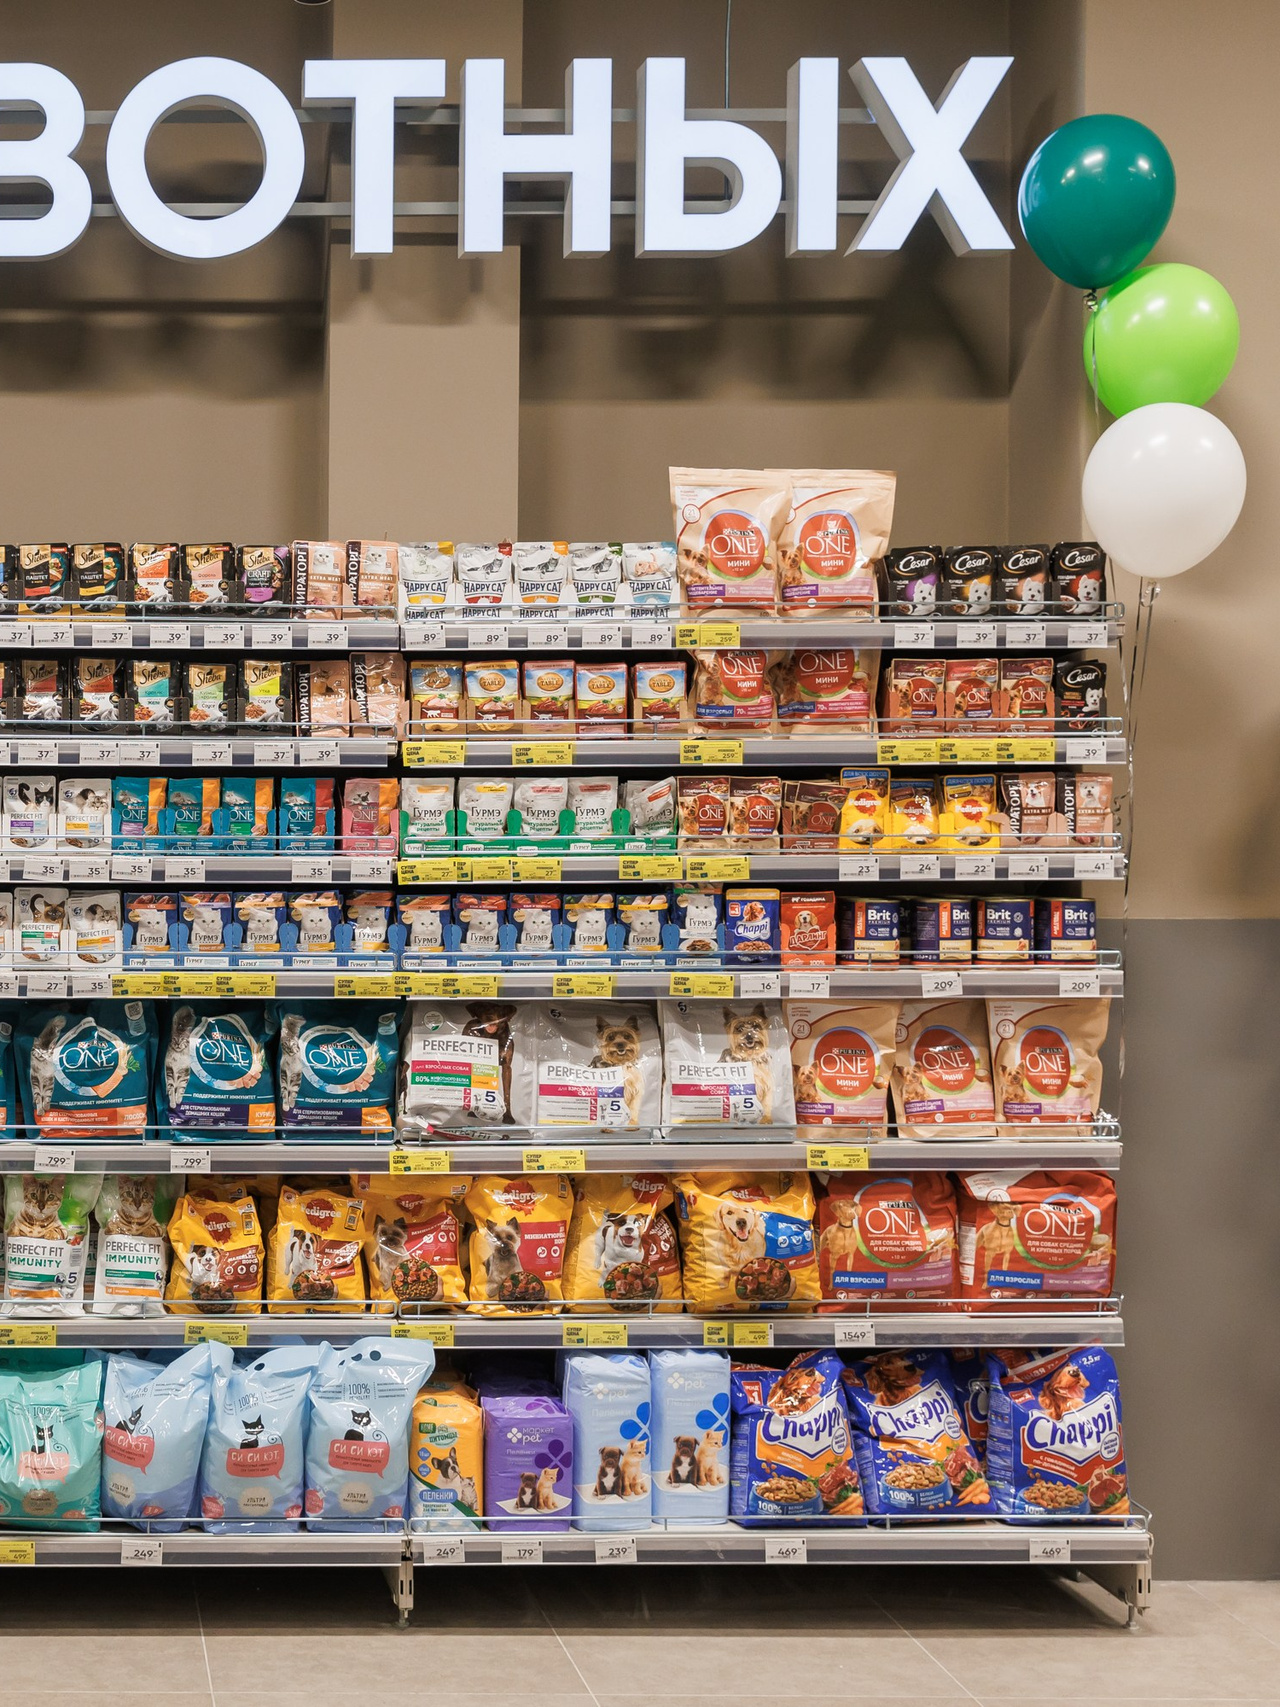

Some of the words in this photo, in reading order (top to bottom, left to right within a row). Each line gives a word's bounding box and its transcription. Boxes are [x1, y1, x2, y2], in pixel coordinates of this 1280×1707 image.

[712, 534, 758, 556] ONE
[806, 534, 852, 556] ONE
[728, 559, 750, 567] МИНИ
[822, 559, 844, 567] МИНИ
[900, 553, 933, 570] Cesar
[955, 555, 988, 572] Cesar
[1009, 553, 1044, 570] Cesar
[404, 582, 431, 592] HAPPY
[433, 582, 446, 592] CAT
[170, 633, 182, 641] 39
[424, 632, 436, 640] 89
[722, 655, 763, 676] ONE
[800, 652, 848, 672] ONE
[816, 676, 839, 684] МИНИ
[1067, 671, 1099, 686] Cesar
[318, 750, 331, 758] 39
[122, 810, 146, 820] ONE
[176, 810, 200, 820] ONE
[414, 807, 444, 818] ГУРМЭ
[472, 806, 502, 818] ГУРМЭ
[576, 806, 606, 818] ГУРМЭ
[868, 910, 891, 921] Brit
[987, 909, 1011, 920] Brit
[1065, 908, 1088, 920] Brit
[734, 922, 768, 936] Chappi
[140, 933, 164, 944] ГУРМЭ
[250, 932, 274, 943] ГУРМЭ
[304, 932, 328, 942] ГУРМЭ
[414, 935, 439, 946] ГУРМЭ
[790, 930, 826, 947] ДАРЛИНГ
[47, 982, 59, 990] 27
[934, 980, 953, 990] 209
[1072, 982, 1092, 990] 209
[423, 1040, 474, 1054] PERFECT
[477, 1044, 494, 1056] FIT
[822, 1053, 868, 1075] ONE
[923, 1051, 969, 1071] ONE
[1026, 1053, 1066, 1072] ONE
[547, 1066, 596, 1080] PERFECT
[600, 1070, 616, 1081] FIT
[679, 1065, 726, 1079] PERFECT
[730, 1066, 747, 1078] FIT
[484, 1091, 496, 1102] 5
[48, 1156, 66, 1165] 799
[183, 1158, 201, 1166] 799
[300, 1206, 342, 1219] Pedigree
[865, 1208, 918, 1235] ONE
[1024, 1208, 1086, 1237] ONE
[8, 1243, 45, 1256] PERFECT
[48, 1246, 64, 1257] FIT
[106, 1241, 142, 1254] PERFECT
[146, 1244, 160, 1254] FIT
[8, 1256, 62, 1268] IMMUNITY
[106, 1253, 160, 1265] IMMUNITY
[835, 1276, 848, 1284] ДЛЯ
[850, 1276, 884, 1284] ВЗРОСЛЫХ
[990, 1275, 1002, 1283] ДЛЯ
[1005, 1276, 1040, 1286] ВЗРОСЛЫХ
[842, 1332, 866, 1340] 1549
[348, 1383, 370, 1396] 100%
[872, 1391, 952, 1439] Chappi
[762, 1404, 841, 1443] Chappi
[1026, 1403, 1114, 1451] Chappi
[522, 1426, 554, 1434] маркет
[522, 1434, 543, 1446] pet
[422, 1492, 454, 1500] ПЕЛЕНКИ
[889, 1490, 915, 1502] 100%
[134, 1550, 154, 1558] 249
[436, 1548, 456, 1556] 249
[516, 1548, 534, 1557] 179
[608, 1548, 628, 1556] 239
[778, 1548, 798, 1556] 469
[1042, 1547, 1062, 1556] 469
